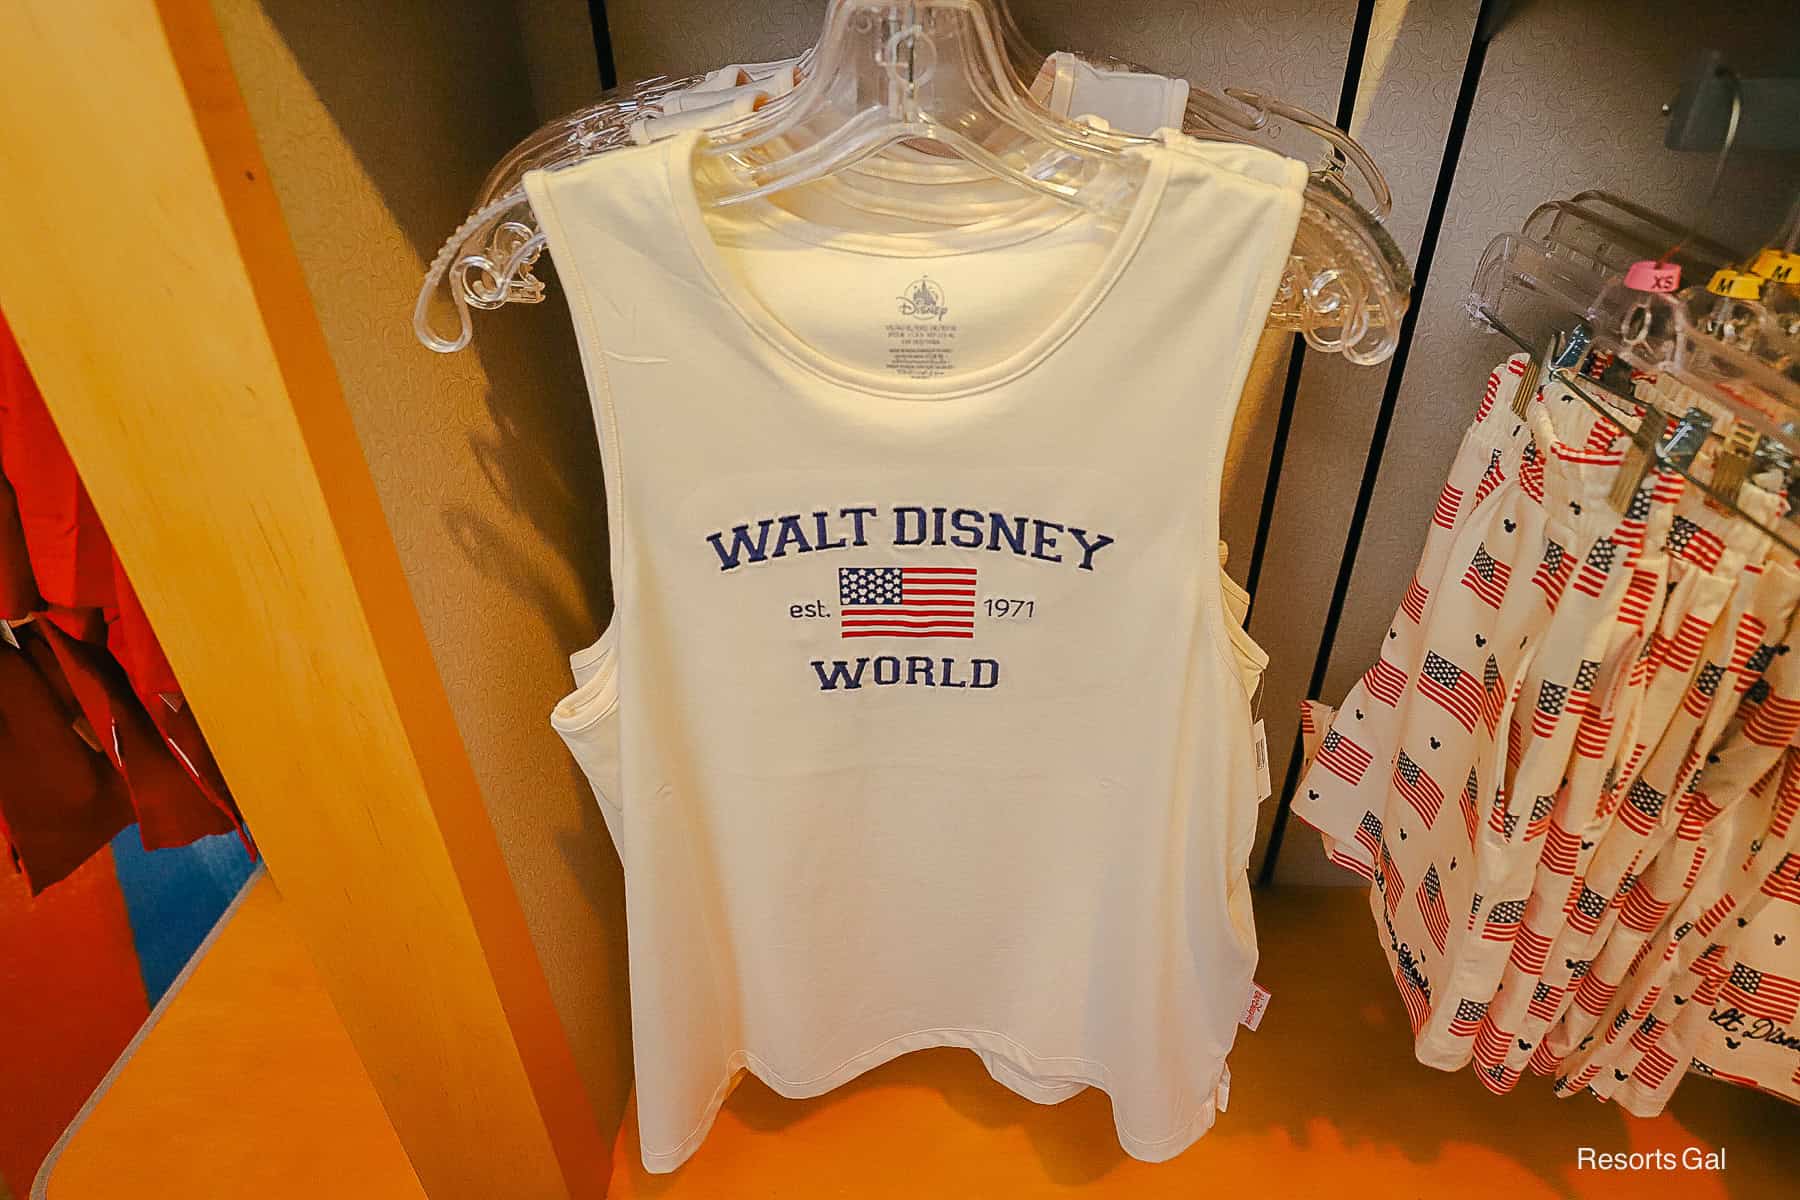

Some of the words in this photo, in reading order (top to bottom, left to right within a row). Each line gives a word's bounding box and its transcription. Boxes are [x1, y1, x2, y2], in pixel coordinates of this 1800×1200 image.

[1651, 275, 1673, 290] XS
[1717, 278, 1735, 293] M
[896, 296, 948, 321] Disney
[706, 507, 877, 571] WALT
[893, 506, 1115, 571] DISNEY
[789, 600, 831, 619] est.
[983, 599, 1036, 619] 1971
[811, 655, 1001, 691] WORLD
